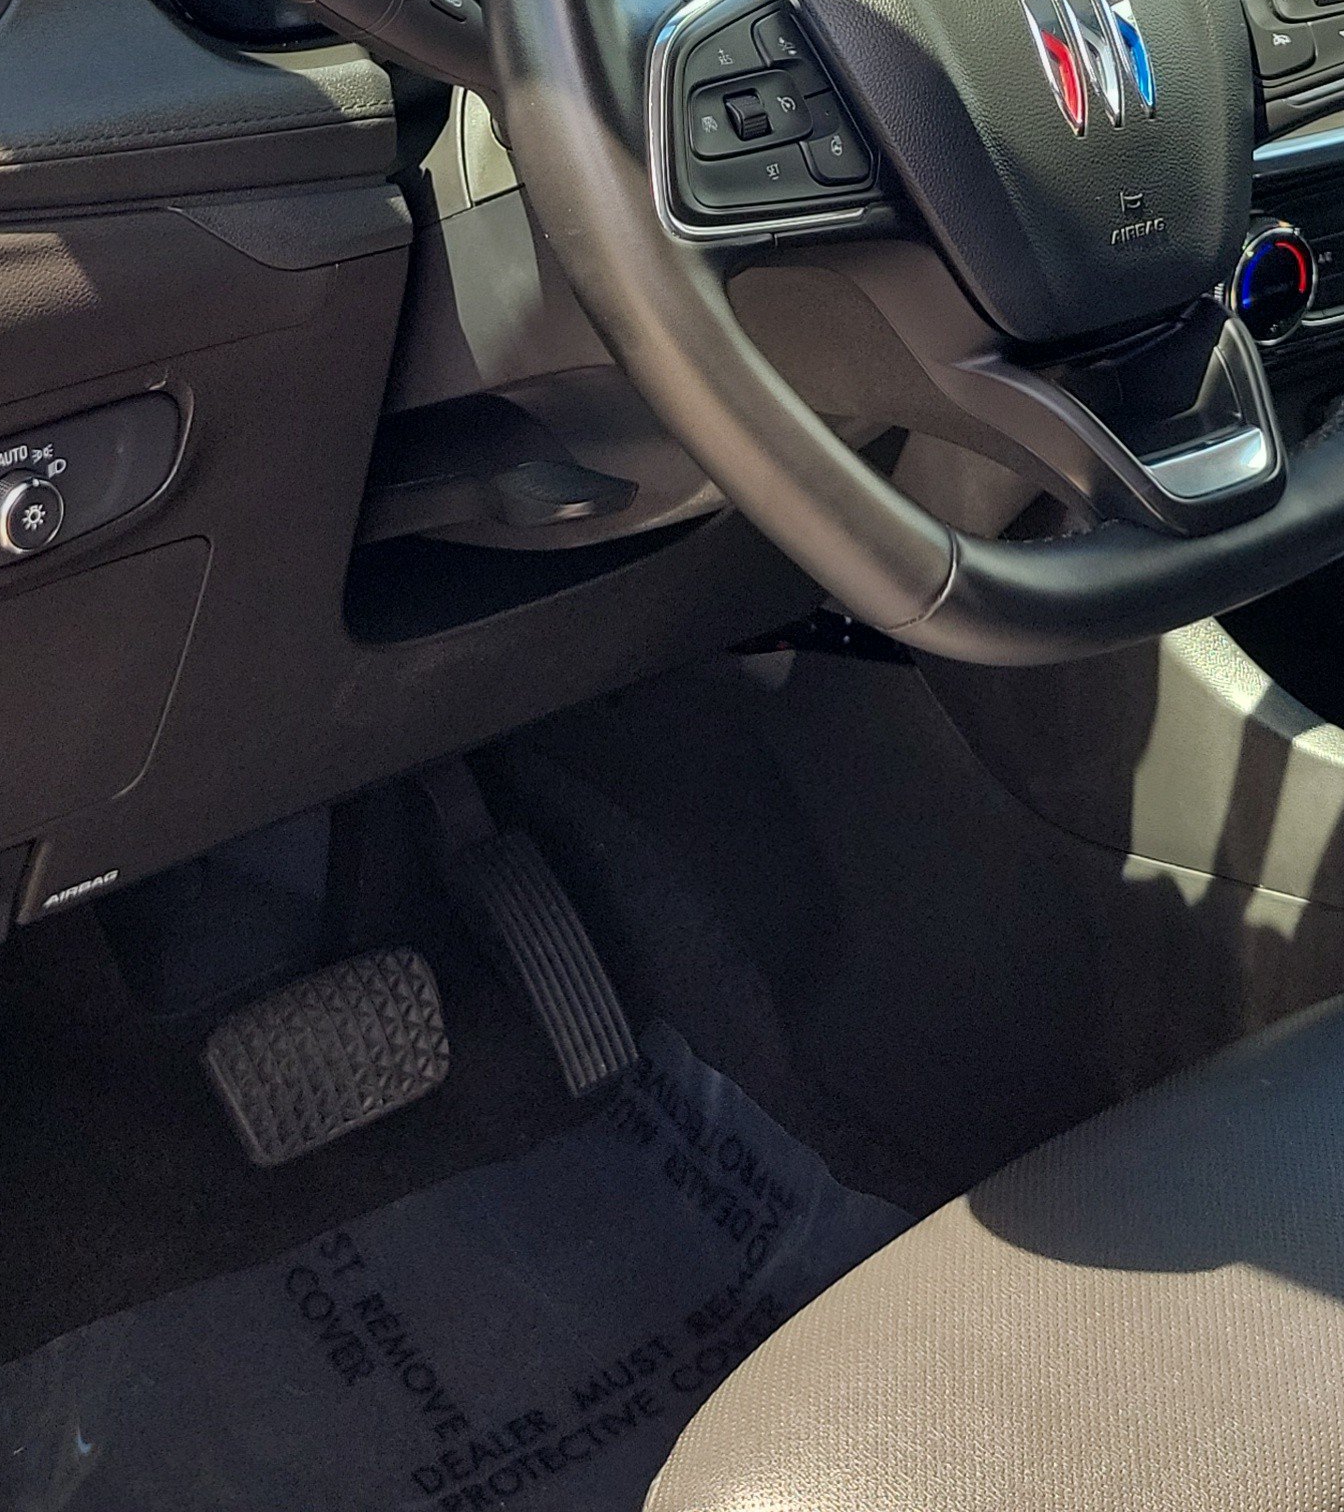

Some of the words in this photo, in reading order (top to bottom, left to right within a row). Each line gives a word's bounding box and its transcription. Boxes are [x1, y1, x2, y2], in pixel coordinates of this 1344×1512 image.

[1111, 218, 1165, 245] AIRBAG
[42, 869, 119, 908] AIRBAG
[285, 1265, 375, 1387] COVER
[319, 1231, 366, 1278] ST
[353, 1291, 471, 1440] REMOVE
[411, 1409, 557, 1496] DEALER
[570, 1336, 674, 1412] MUST
[439, 1387, 664, 1512] PROTECTIVE
